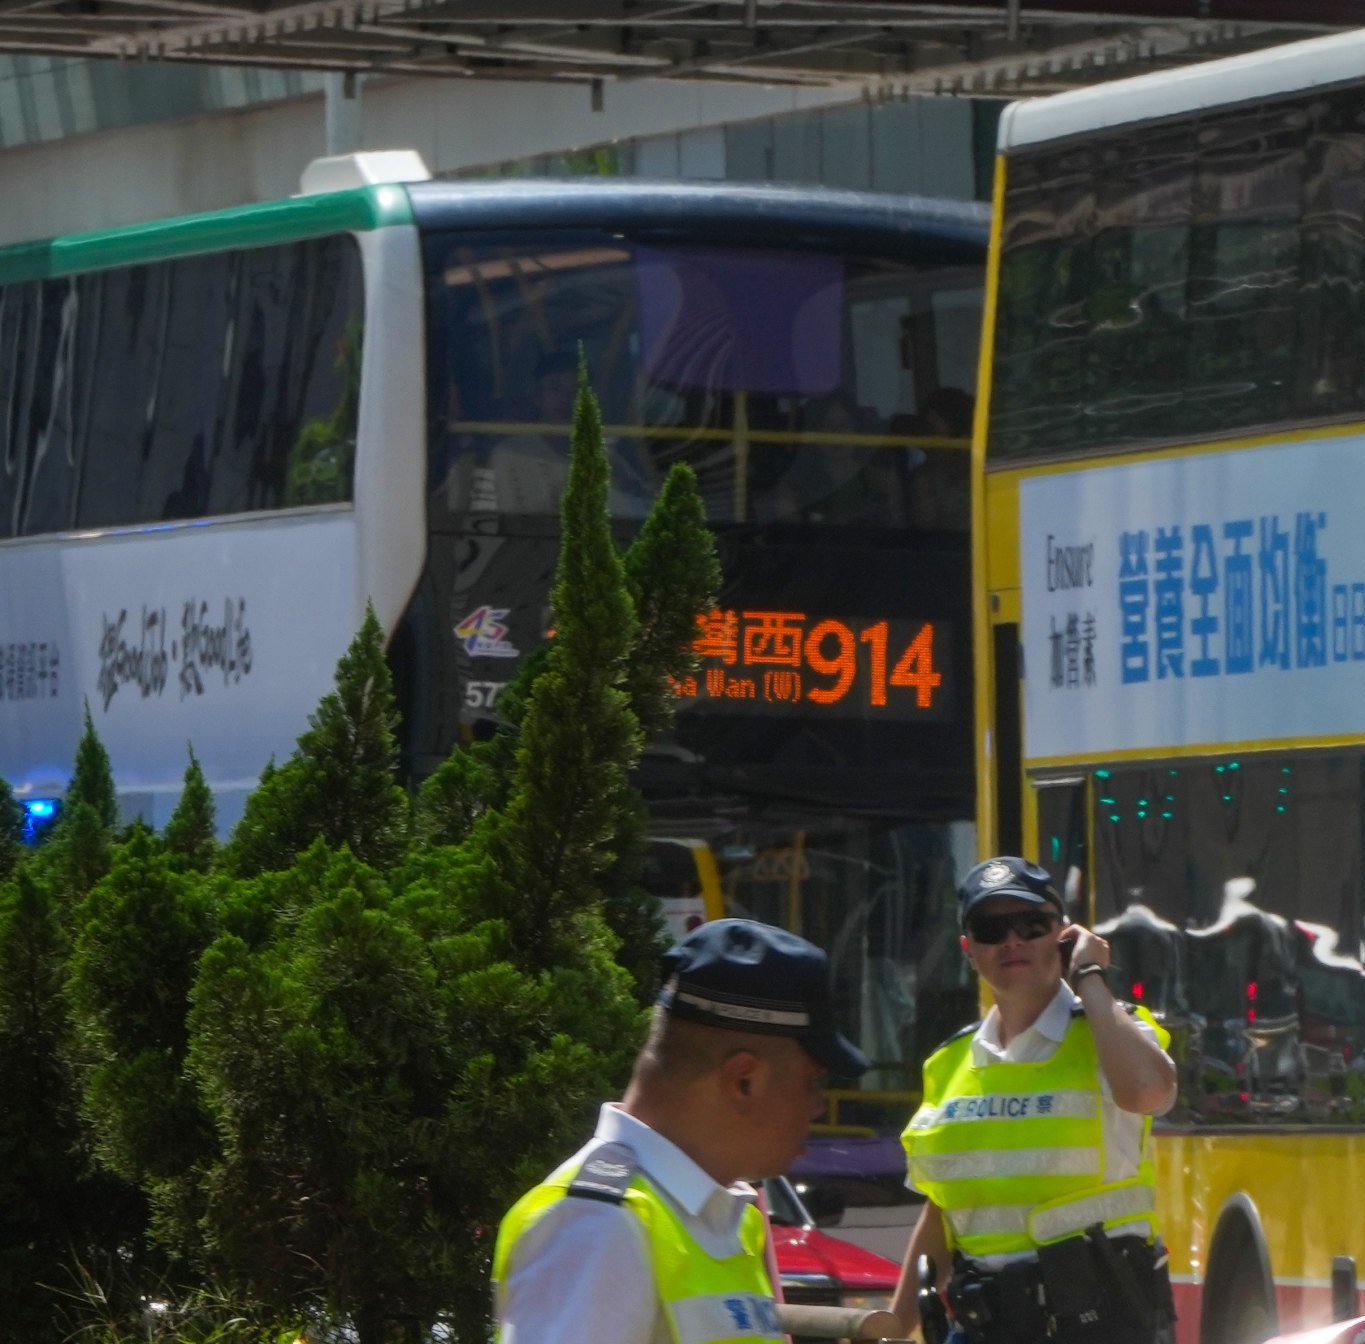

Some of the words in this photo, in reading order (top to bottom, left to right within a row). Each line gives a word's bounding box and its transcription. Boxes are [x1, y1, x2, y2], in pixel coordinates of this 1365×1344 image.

[1047, 534, 1095, 593] Ensure
[1117, 511, 1328, 685] 營養全面均衡
[706, 668, 756, 698] Wan
[803, 619, 942, 708] 914
[465, 681, 507, 709] 57
[966, 1097, 1031, 1118] POLICE
